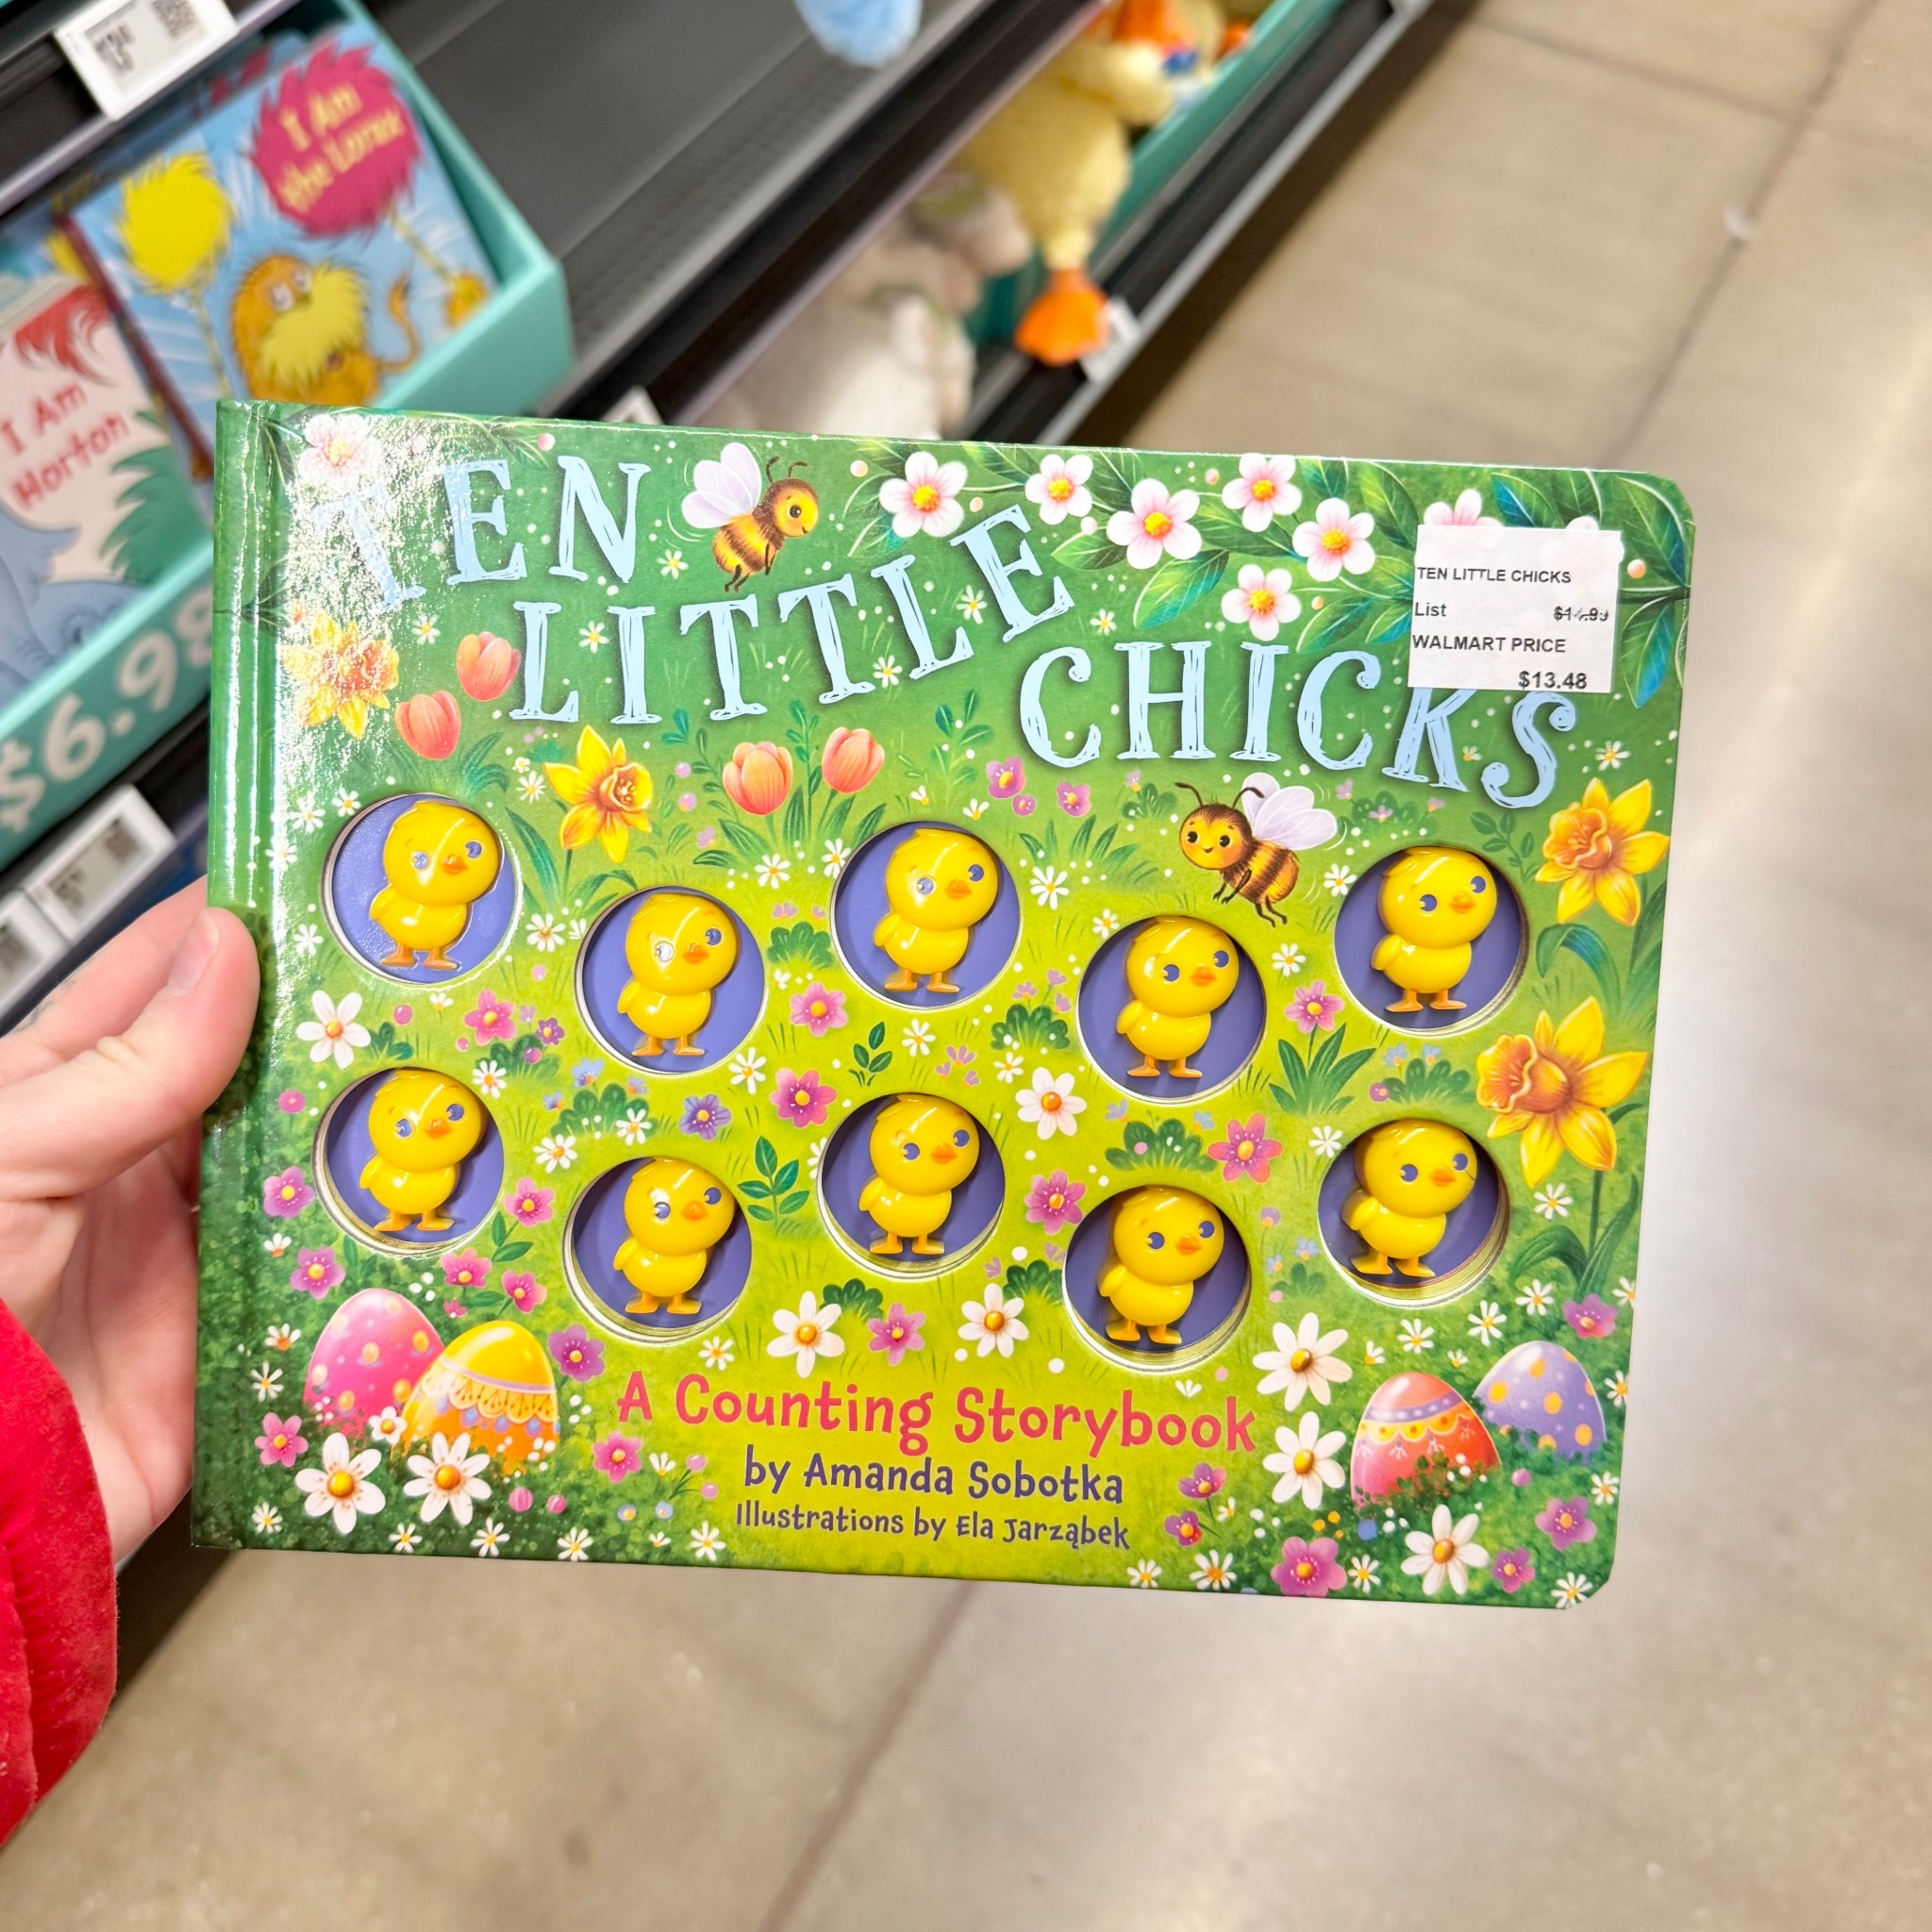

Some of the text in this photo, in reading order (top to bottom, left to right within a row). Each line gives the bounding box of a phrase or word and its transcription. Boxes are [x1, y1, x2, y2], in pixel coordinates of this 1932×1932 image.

[0, 385, 87, 457] I Am
[13, 413, 130, 510] Horton
[310, 456, 651, 615] TEN
[1417, 566, 1572, 584] TEN LITTLE CHICKS
[508, 505, 1074, 724] LITTLE
[1414, 602, 1447, 617] List
[1412, 635, 1566, 653] WALMART PRICE
[1518, 670, 1588, 691] $13.48
[1019, 641, 1577, 808] CHICKS
[616, 1370, 1256, 1459] A Counting Storybook
[744, 1443, 1124, 1505] by Amanda Sobotka
[736, 1500, 1131, 1550] Illustrations by Ela Jarząbek
